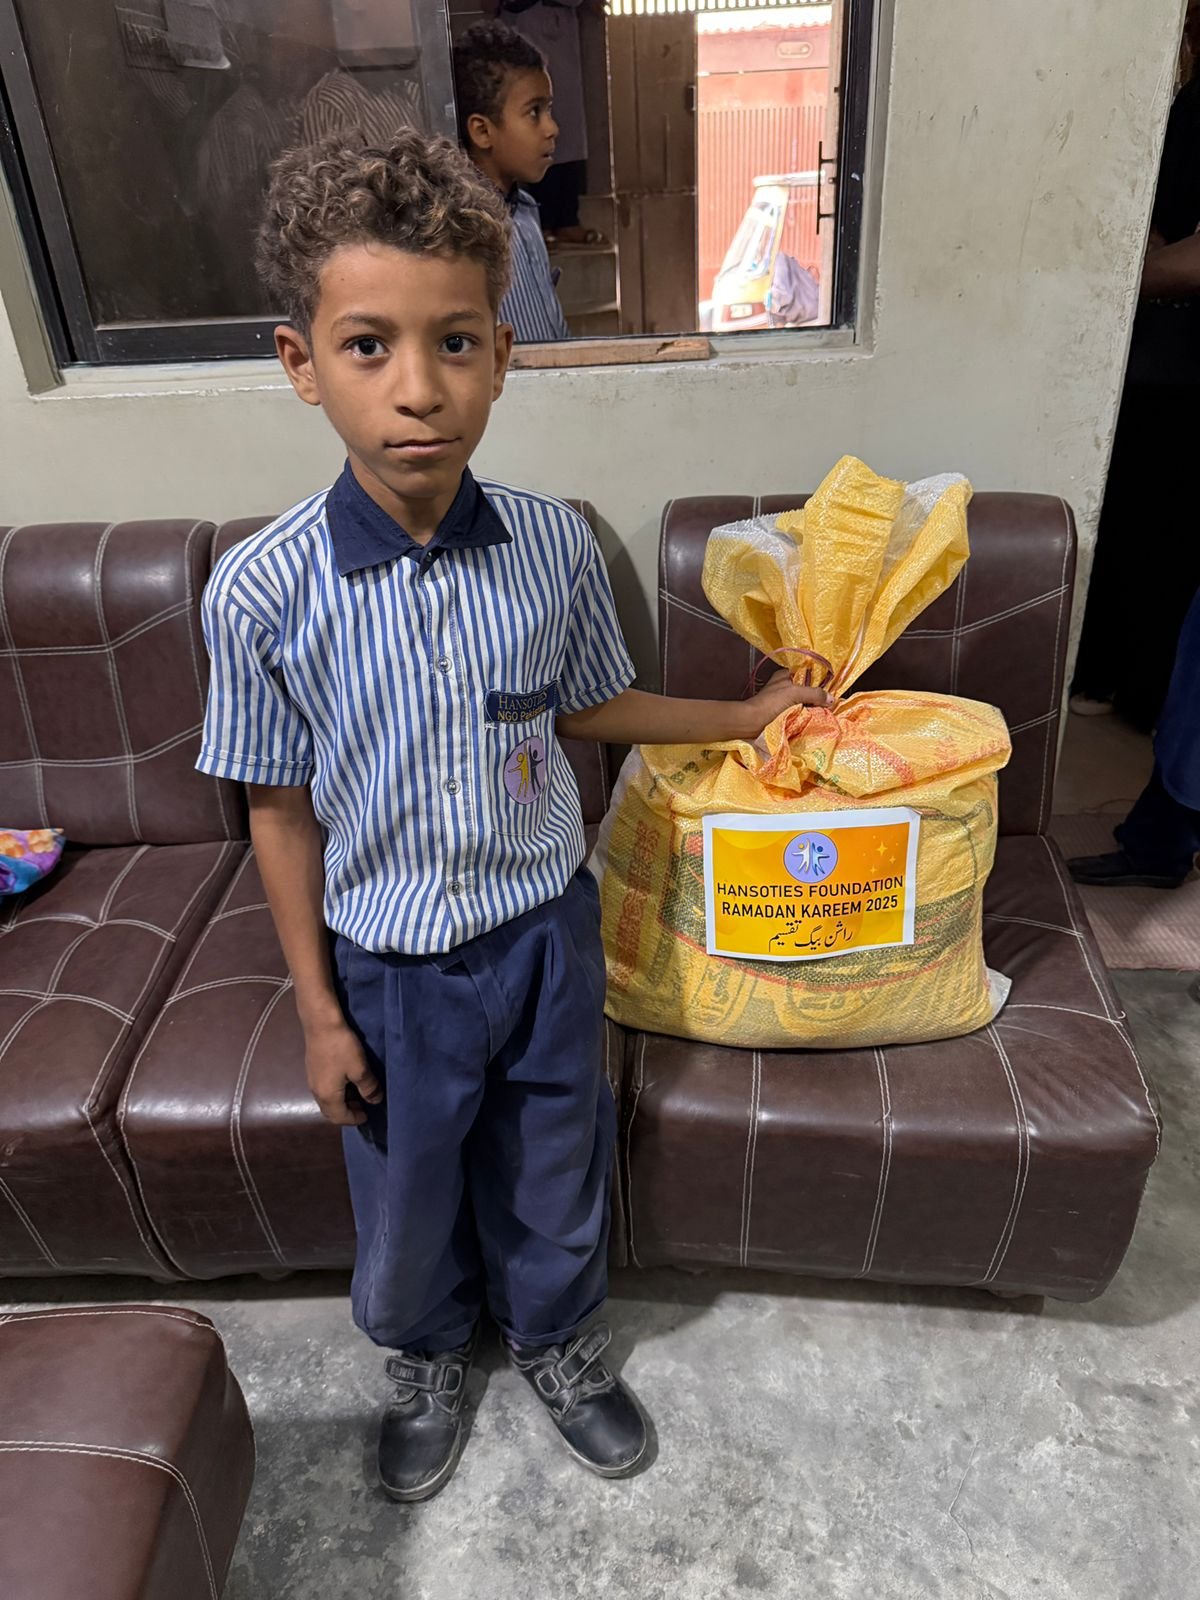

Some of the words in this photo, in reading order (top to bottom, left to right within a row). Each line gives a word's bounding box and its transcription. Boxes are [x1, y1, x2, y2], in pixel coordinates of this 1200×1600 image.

[497, 710, 519, 722] NGO
[717, 882, 803, 898] HANSOTIES
[809, 875, 904, 897] FOUNDATION
[722, 901, 796, 919] RAMADAN
[801, 900, 861, 919] KAREEM
[865, 894, 898, 912] 2025
[824, 920, 853, 947] راشن
